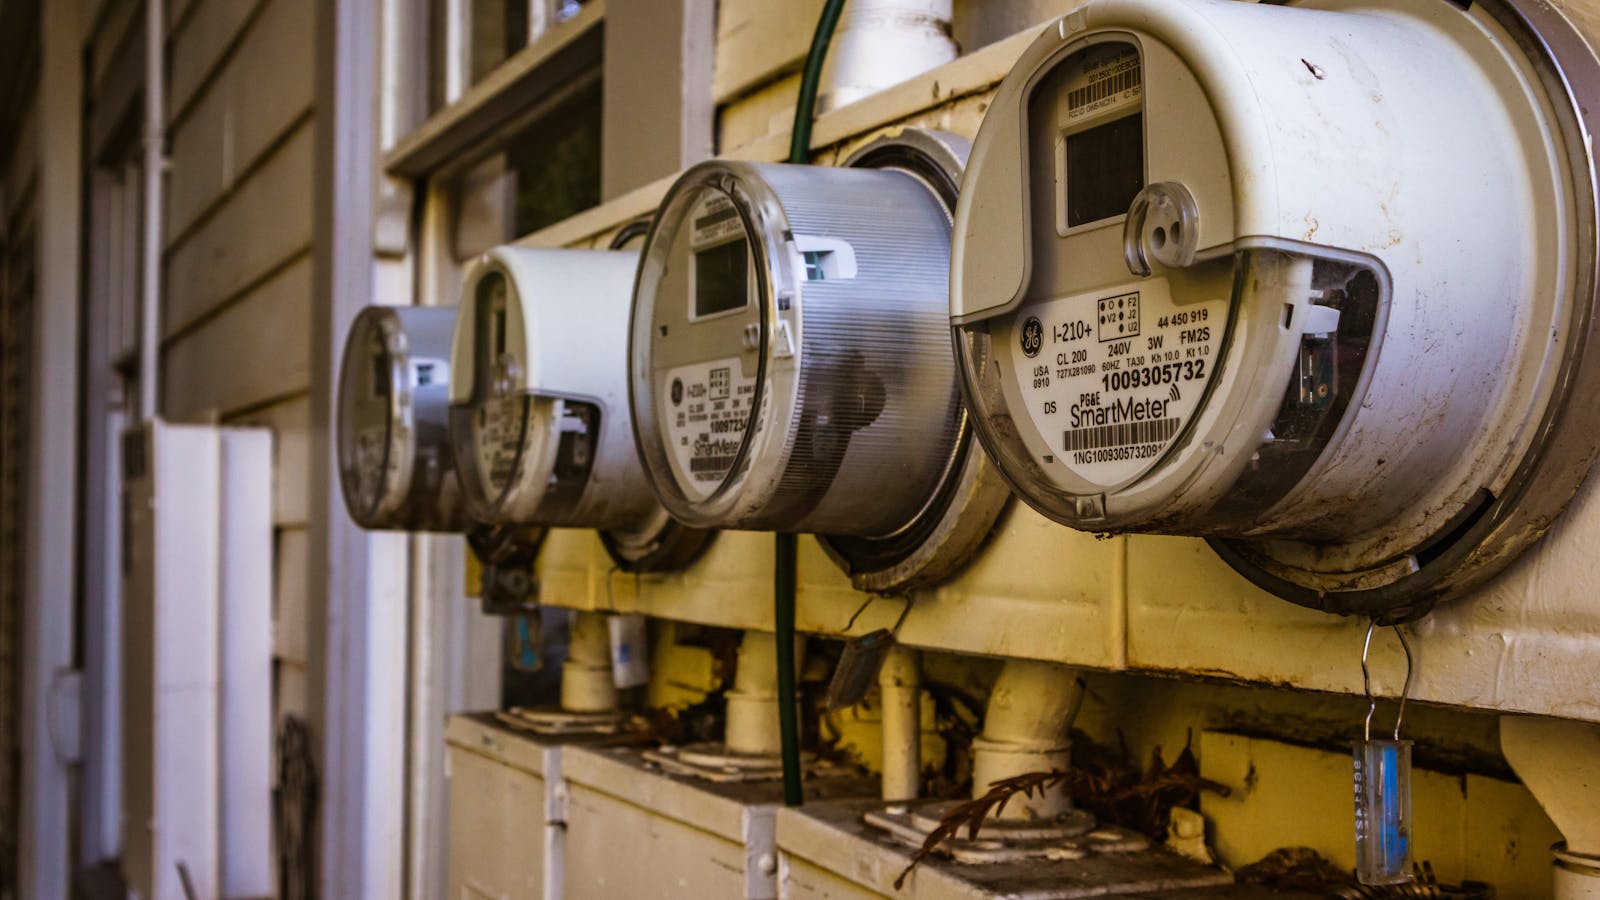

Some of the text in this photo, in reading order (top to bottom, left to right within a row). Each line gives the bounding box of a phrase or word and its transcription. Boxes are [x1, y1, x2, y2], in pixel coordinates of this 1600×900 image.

[1128, 297, 1137, 308] F2
[1106, 313, 1117, 323] V2
[1128, 309, 1137, 320] J2
[1157, 308, 1208, 328] 44 450 919
[1053, 320, 1092, 344] I-210+
[1127, 322, 1138, 333] U2
[1056, 326, 1211, 367] CL 200 240V 3W FM2S
[1126, 355, 1145, 368] TA30
[1151, 353, 1162, 364] Kh
[1164, 350, 1180, 361] 10.0
[1198, 345, 1210, 356] 1.0
[1033, 365, 1050, 378] USA
[1102, 358, 1205, 393] 1009305732
[1033, 377, 1050, 389] 0910
[1044, 401, 1057, 415] DS
[1080, 392, 1100, 408] PG&E
[1070, 396, 1170, 428] SmartMeter
[1073, 444, 1168, 465] 1NG1009305732091
